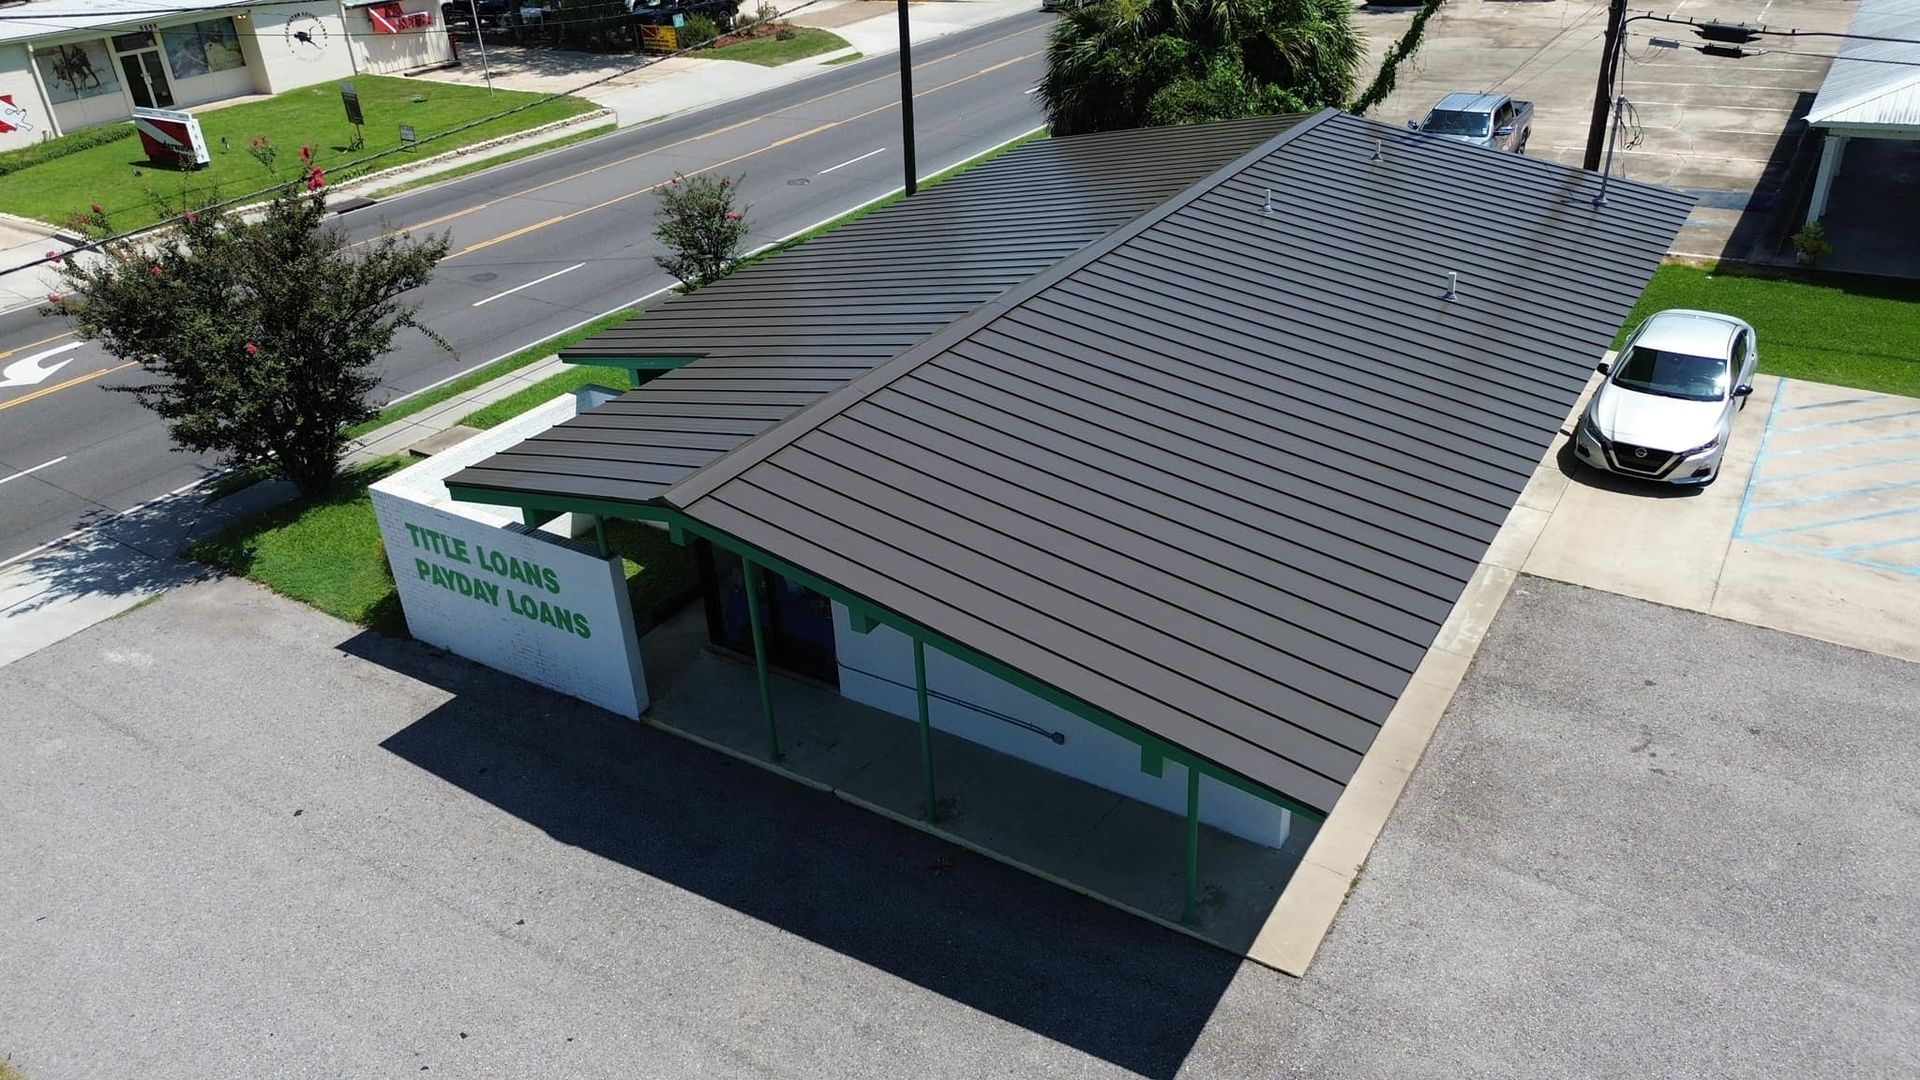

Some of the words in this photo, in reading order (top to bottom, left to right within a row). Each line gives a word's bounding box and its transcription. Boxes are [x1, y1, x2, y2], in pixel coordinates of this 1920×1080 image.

[405, 522, 471, 564] TITLE
[476, 545, 560, 594] LOANS
[414, 558, 500, 607] PAYDAY
[507, 589, 591, 639] LOANS
